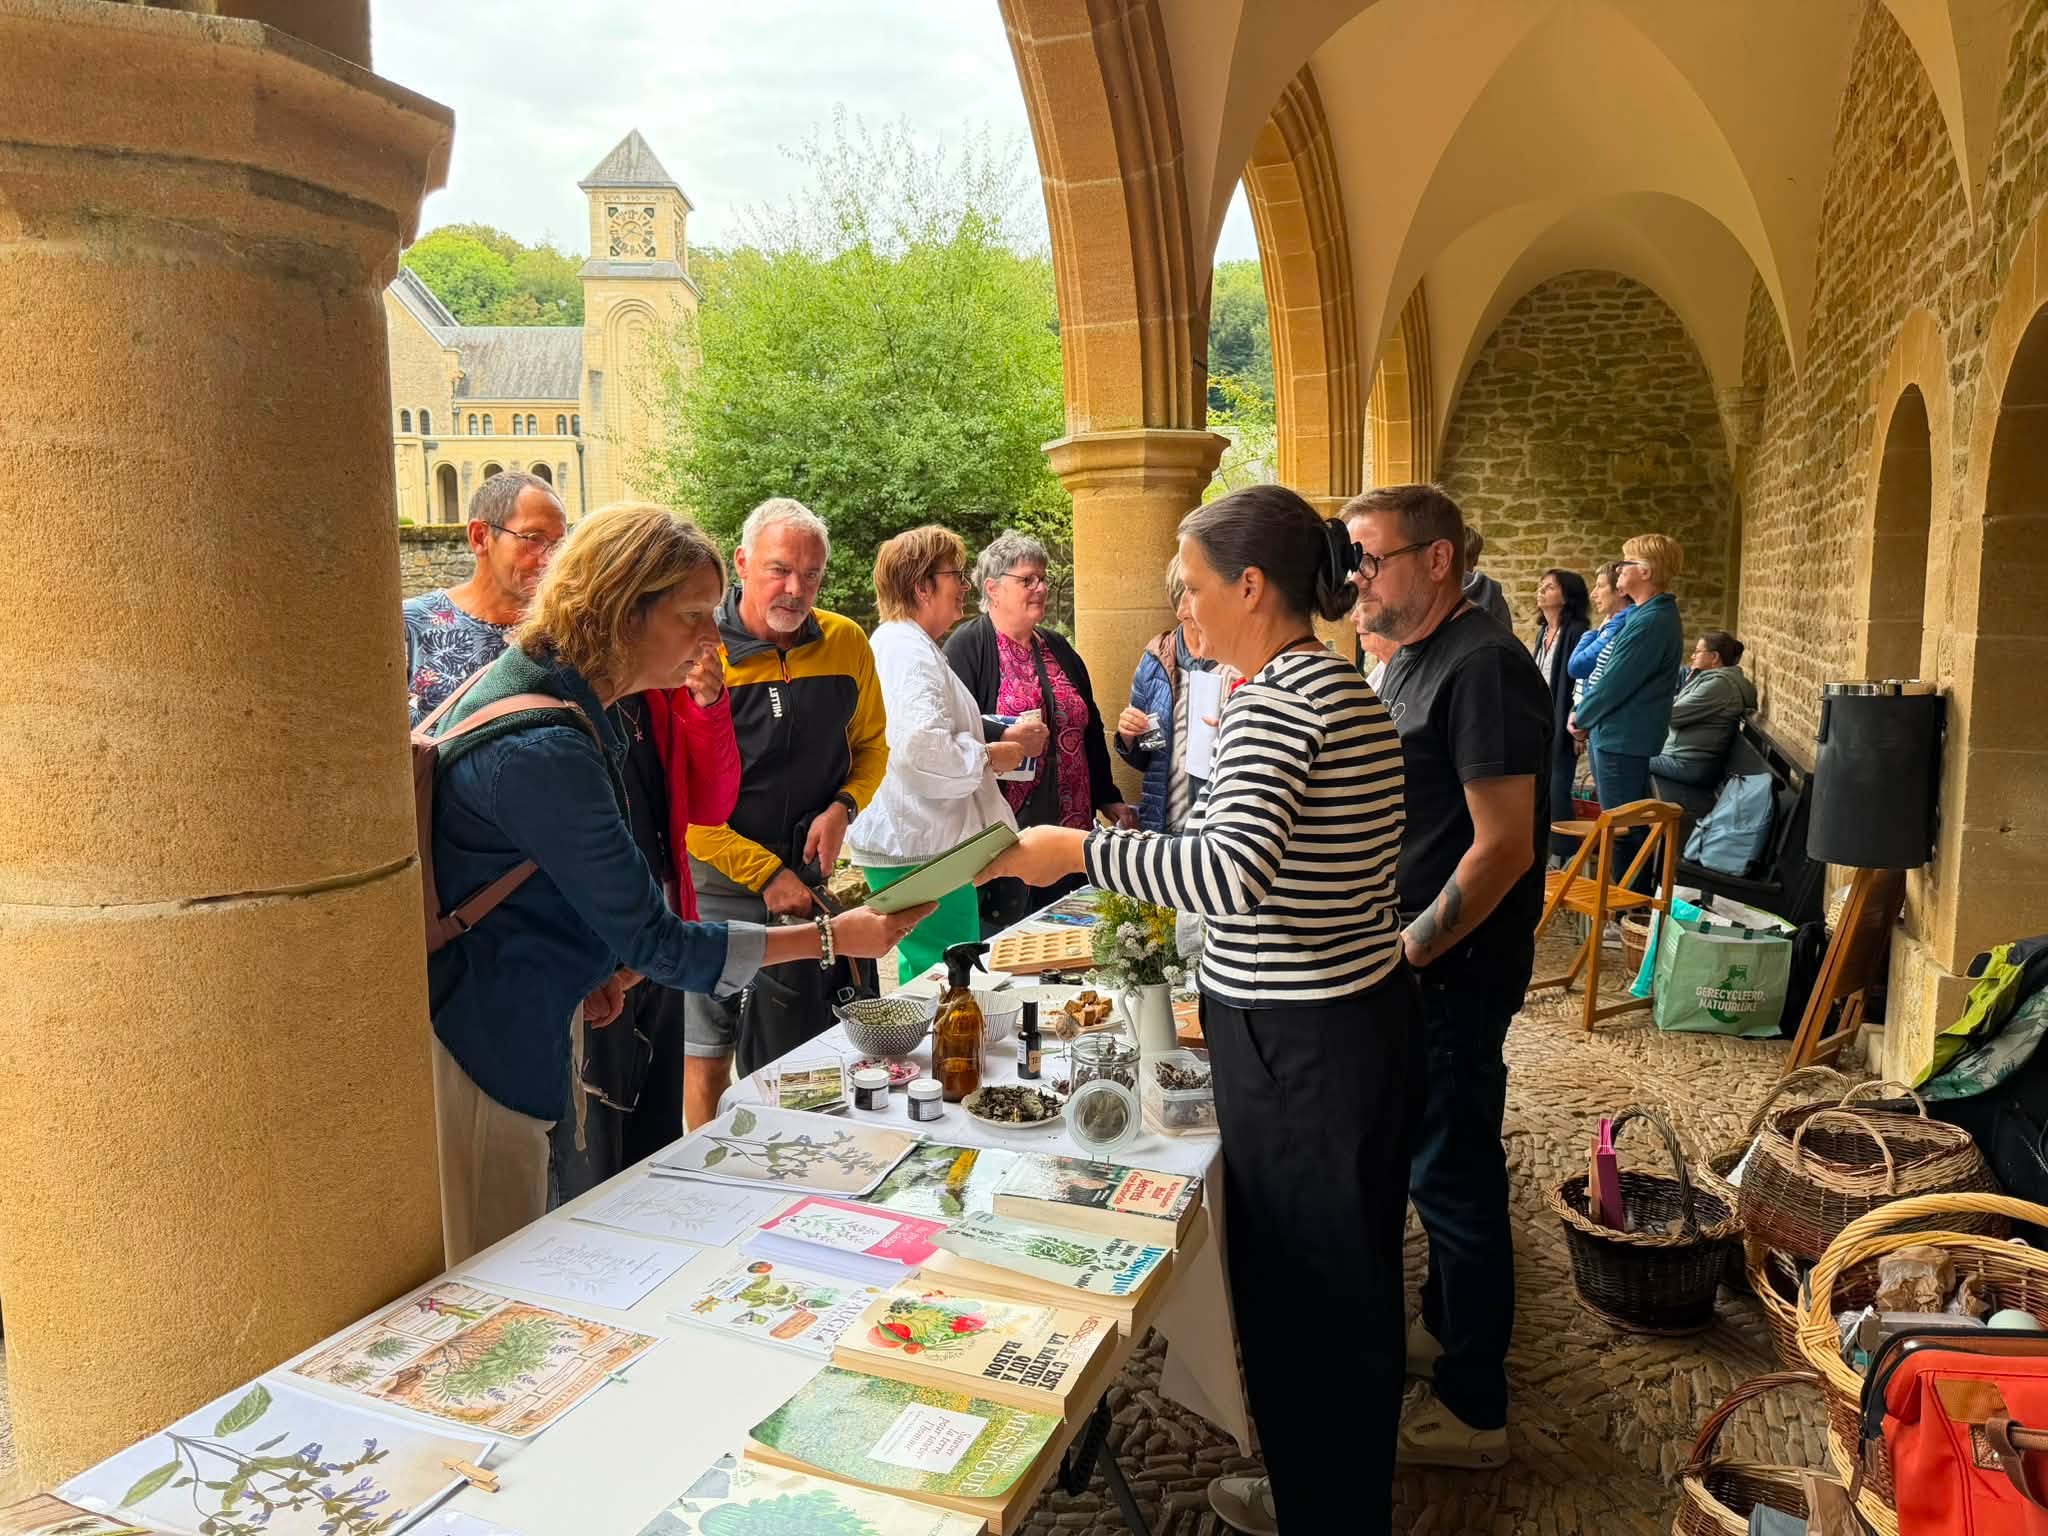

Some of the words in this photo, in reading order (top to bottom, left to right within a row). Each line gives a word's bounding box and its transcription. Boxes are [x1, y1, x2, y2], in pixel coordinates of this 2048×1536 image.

[768, 686, 783, 718] MILLET
[1047, 1332, 1069, 1345] LA
[982, 1340, 1023, 1379] RAISON
[1010, 1355, 1033, 1374] QUI
[1019, 1346, 1058, 1388] NATURE
[1000, 1373, 1018, 1382] A
[1038, 1361, 1069, 1391] C'EST
